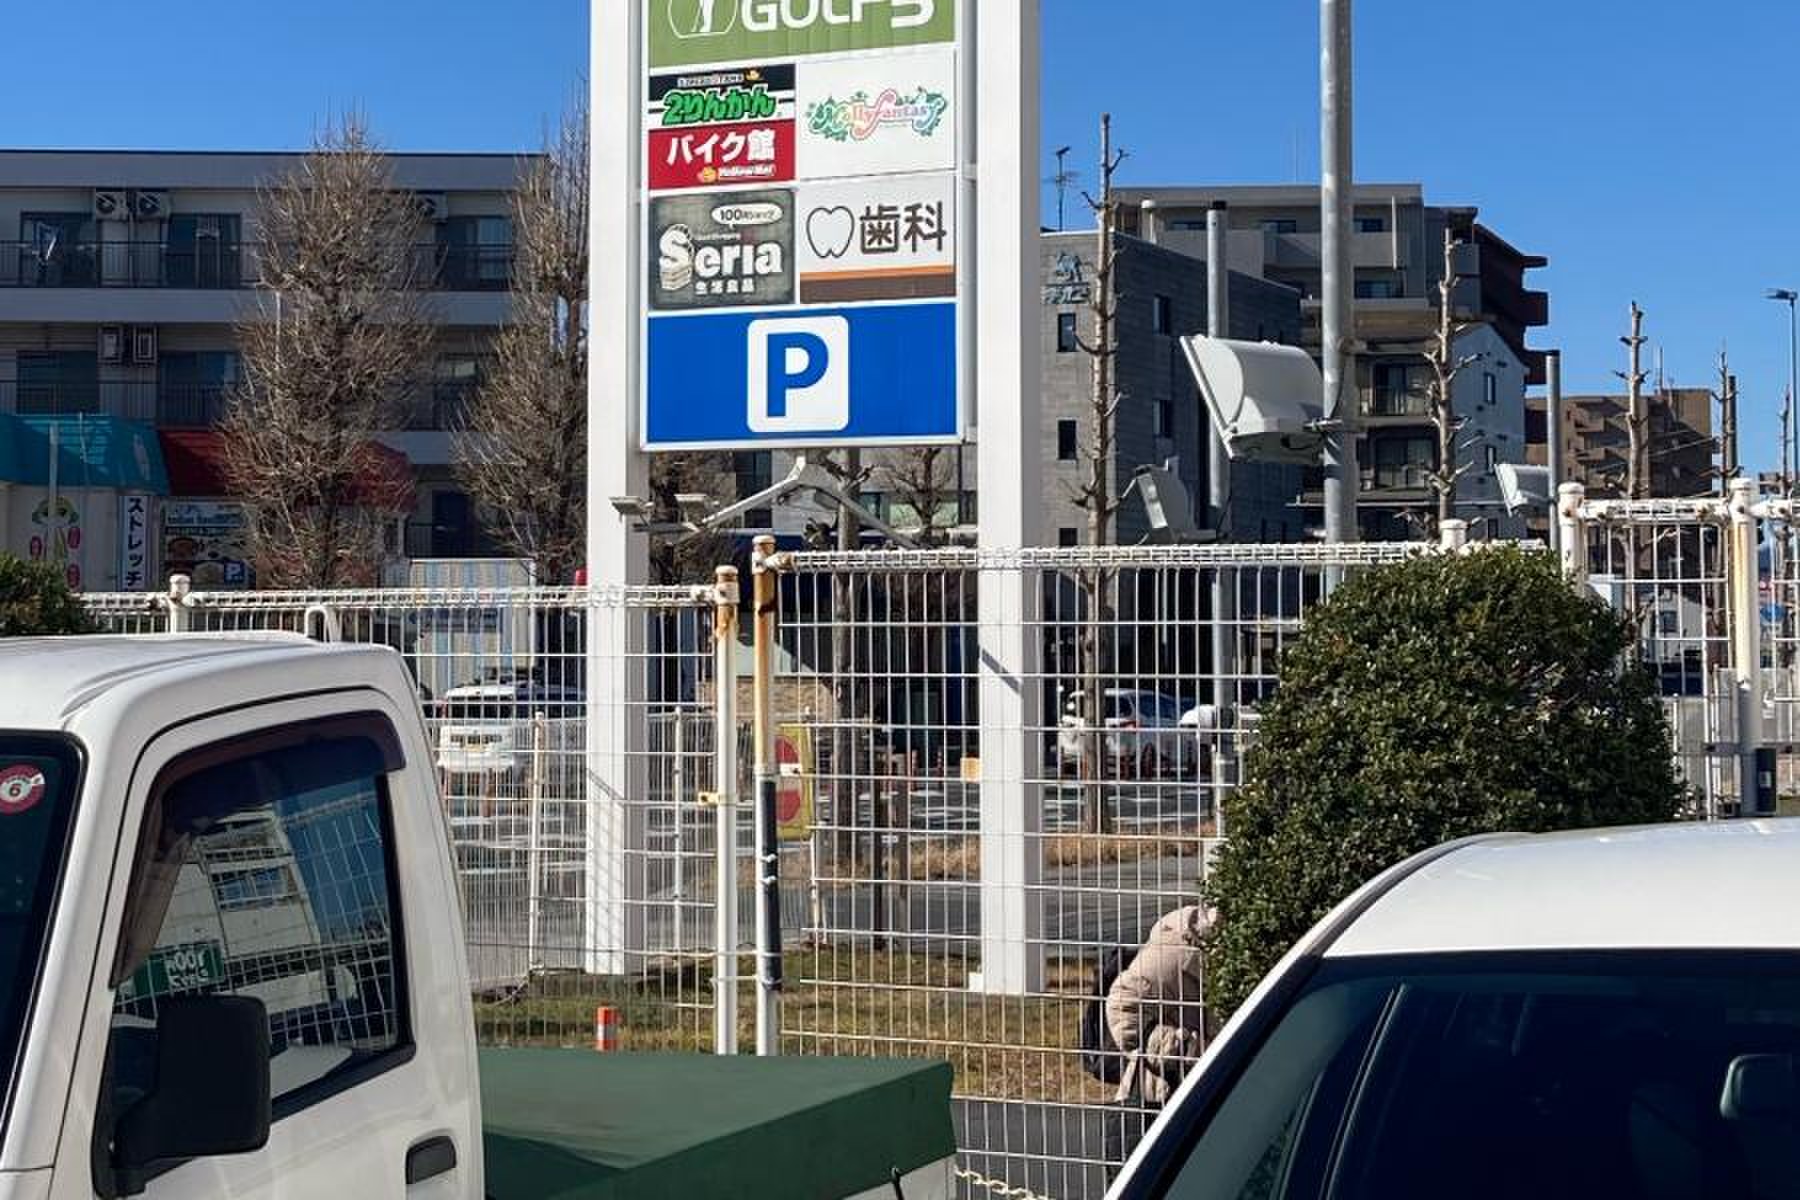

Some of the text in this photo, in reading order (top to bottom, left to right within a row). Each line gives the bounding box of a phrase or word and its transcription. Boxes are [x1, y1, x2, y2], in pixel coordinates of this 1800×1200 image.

[666, 129, 775, 166] バイク館
[659, 224, 783, 290] Seria
[860, 202, 947, 255] 歯科
[766, 332, 829, 418] P
[126, 497, 145, 587] ストレッチ
